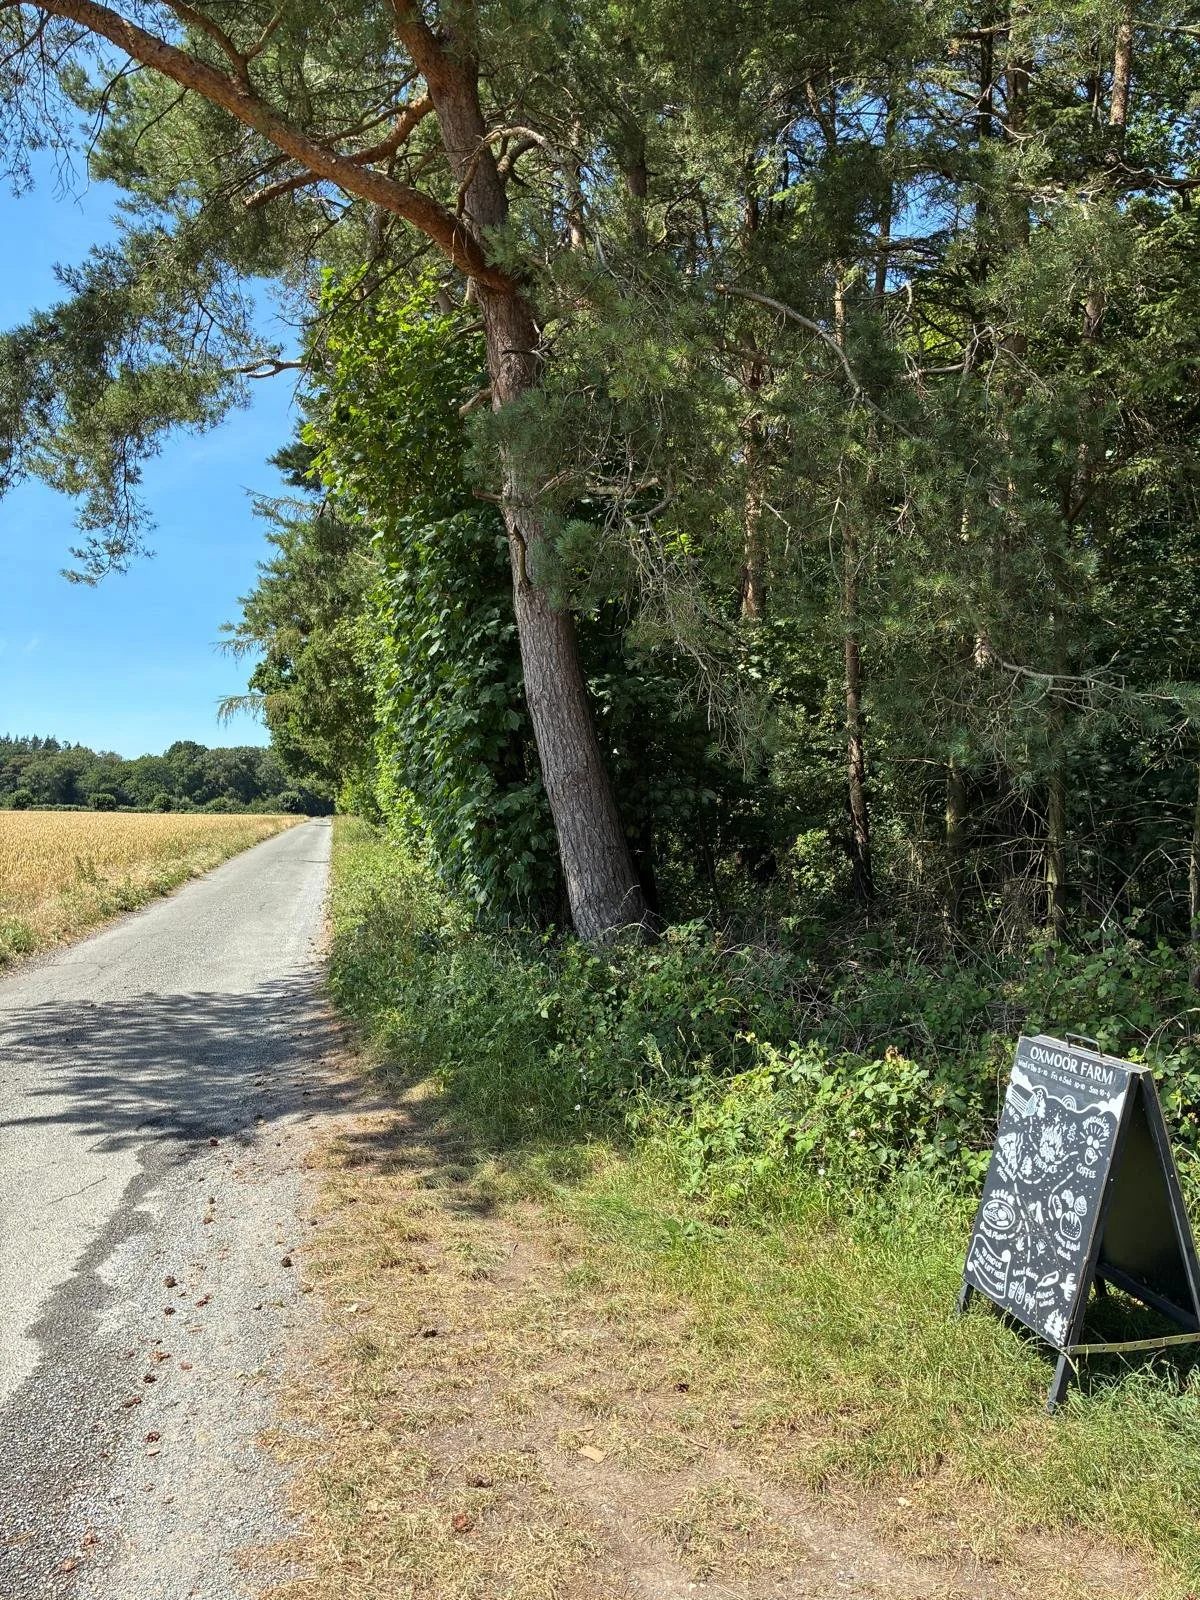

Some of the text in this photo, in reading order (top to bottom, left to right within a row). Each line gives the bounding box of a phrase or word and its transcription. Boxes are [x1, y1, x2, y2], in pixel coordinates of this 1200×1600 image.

[1030, 1046, 1114, 1085] OXMOOR FARM
[1062, 1076, 1072, 1086] Sat
[1088, 1085, 1099, 1095] Sun
[1033, 1153, 1058, 1174] FIREPLACE
[1076, 1162, 1097, 1179] COFFEE
[981, 1247, 988, 1256] TO
[975, 1247, 1006, 1281] TURN LEFT HERE
[1012, 1266, 1026, 1277] Local
